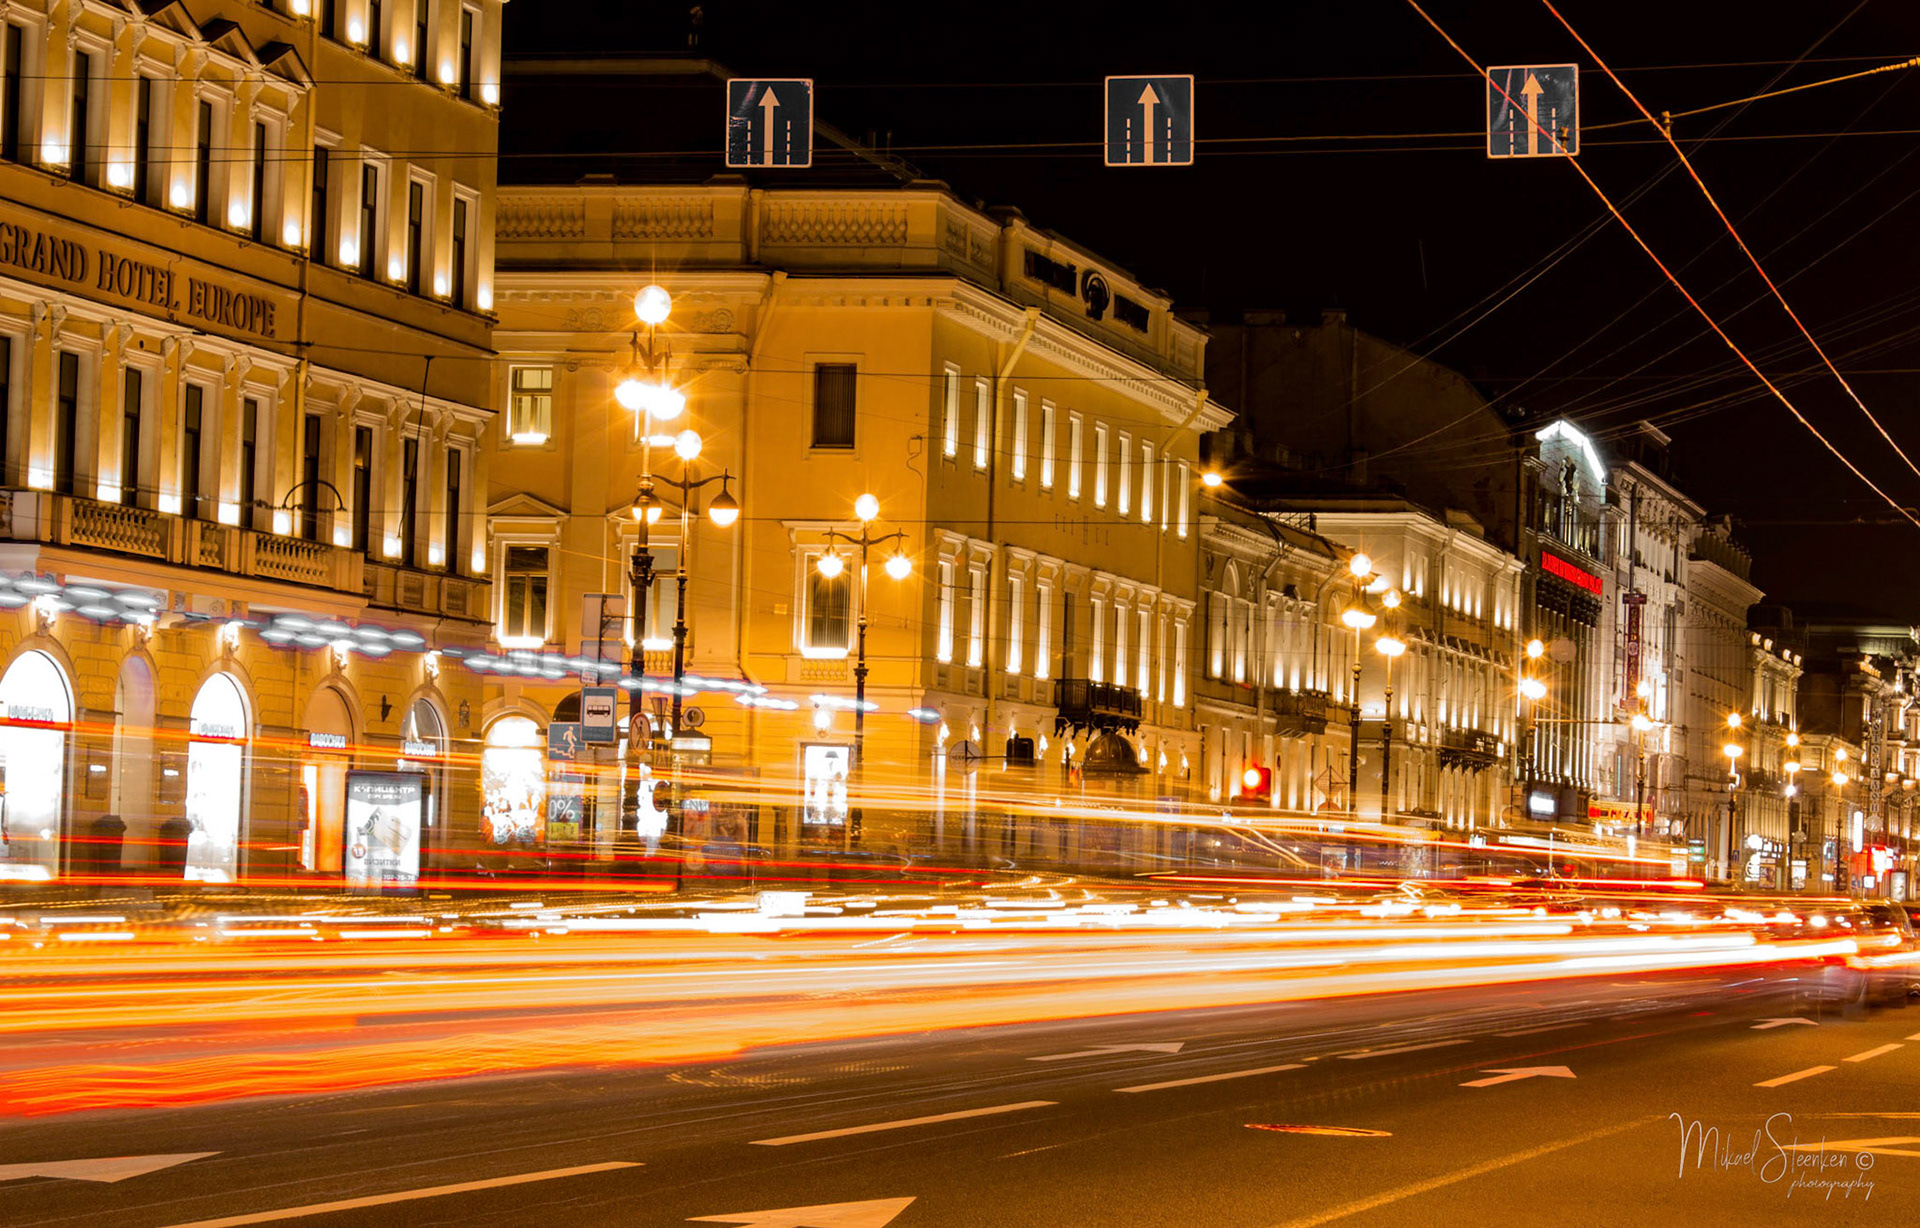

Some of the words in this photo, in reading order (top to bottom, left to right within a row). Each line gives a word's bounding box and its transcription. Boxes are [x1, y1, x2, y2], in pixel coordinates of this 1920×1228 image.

[0, 221, 89, 283] GRAND
[97, 250, 180, 311] HOTEL
[188, 277, 276, 338] EUROPE
